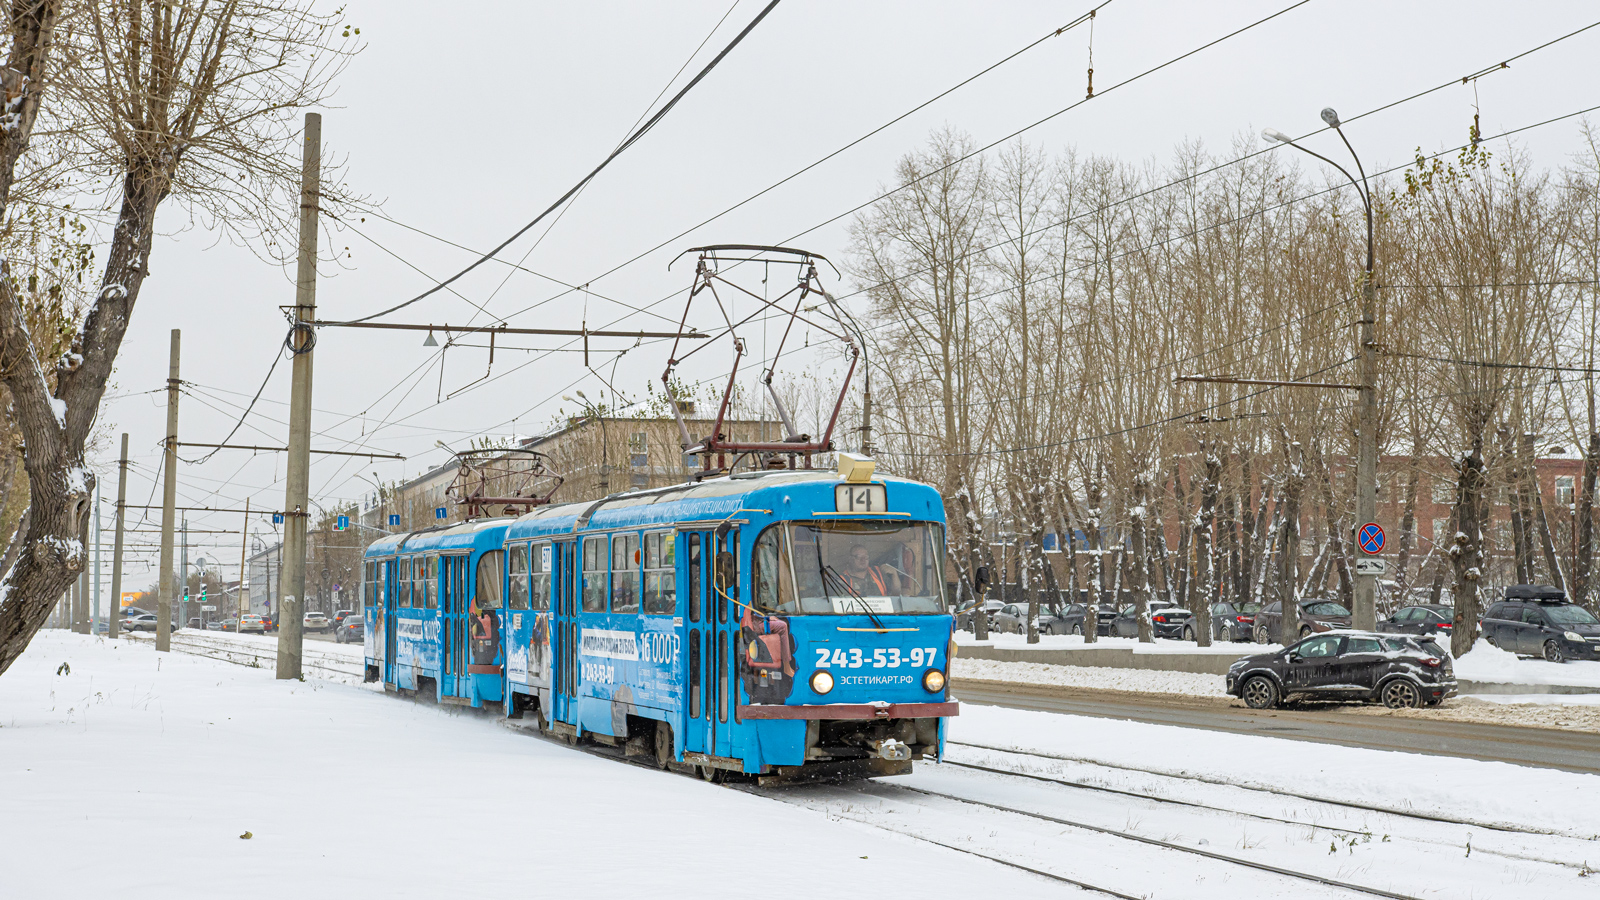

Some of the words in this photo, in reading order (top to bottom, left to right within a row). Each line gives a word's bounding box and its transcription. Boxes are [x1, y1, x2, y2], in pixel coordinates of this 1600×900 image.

[845, 487, 872, 512] 14
[652, 633, 672, 664] 000
[815, 647, 937, 668] 243-53-97
[586, 662, 614, 685] 243-53-97
[840, 674, 913, 685] ЭСТЕТИКАРТ.РФ
